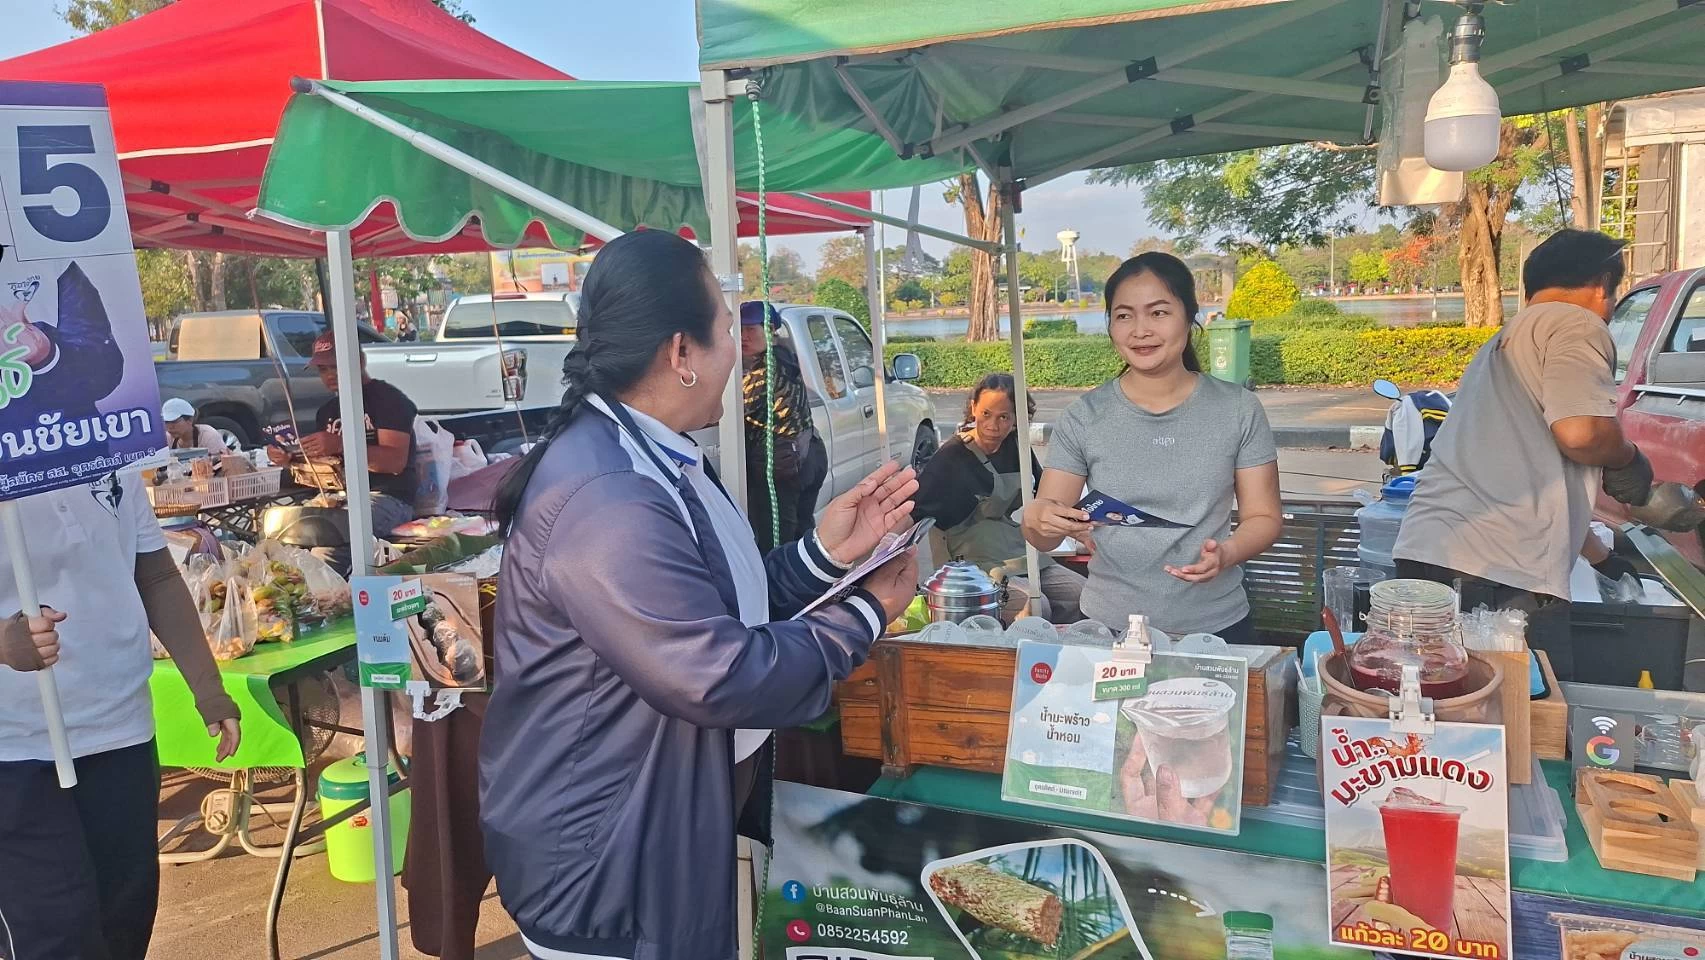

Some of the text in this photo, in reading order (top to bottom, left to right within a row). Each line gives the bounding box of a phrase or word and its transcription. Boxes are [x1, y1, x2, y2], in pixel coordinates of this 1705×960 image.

[17, 125, 111, 242] 5
[0, 409, 151, 460] นชัยเขา
[1102, 666, 1137, 679] 20 บาท
[1040, 704, 1090, 727] น้ำมะพร้าว
[1046, 724, 1080, 744] น้ำหอม
[1330, 756, 1491, 807] มะขามแดง
[812, 883, 924, 913] บ้านสวนพันธุ์ล้าน
[815, 903, 928, 924] @BaanSuanPhanLan
[817, 923, 909, 945] 0852254592
[1340, 922, 1499, 959] แก้วละ 20 บาท
